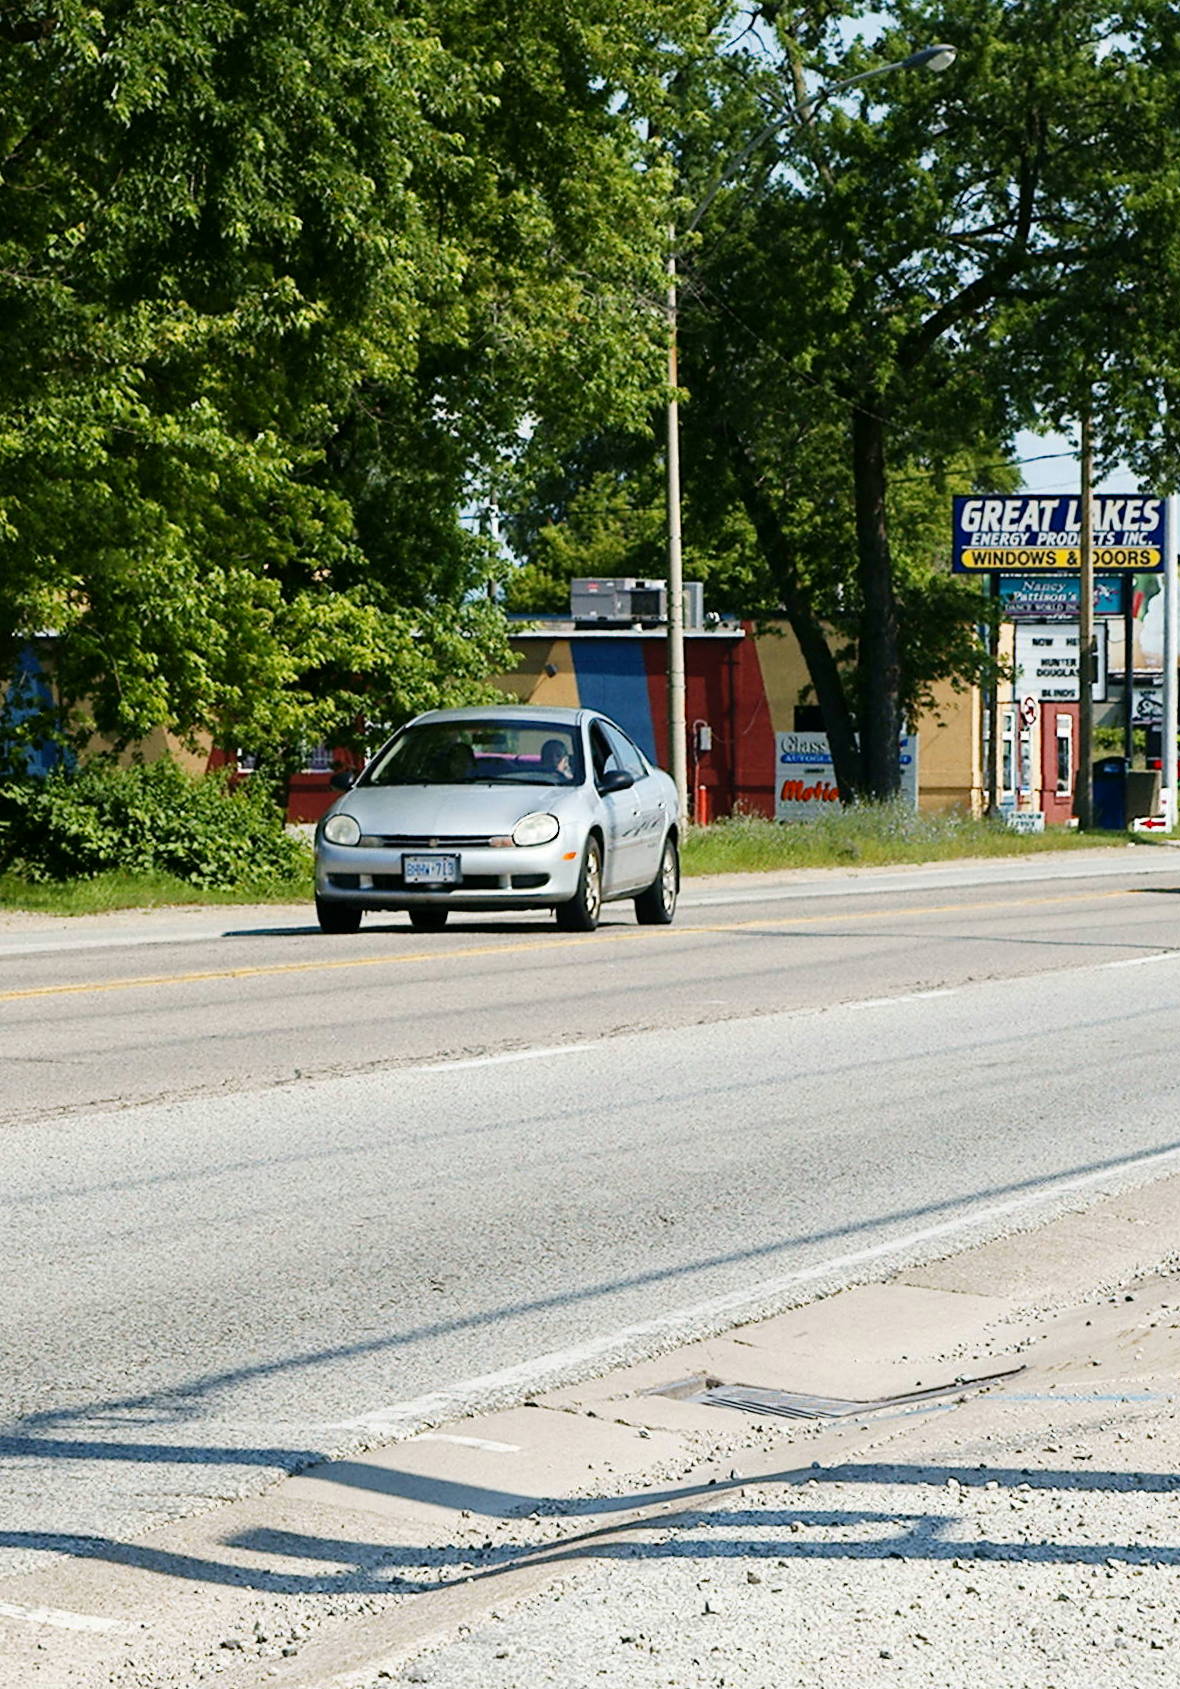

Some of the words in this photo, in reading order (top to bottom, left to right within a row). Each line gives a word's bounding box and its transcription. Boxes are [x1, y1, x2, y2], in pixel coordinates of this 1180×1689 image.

[961, 499, 1059, 532] GREAT
[971, 532, 1029, 546] ENERGY
[1037, 532, 1115, 546] PRODTS
[1122, 532, 1153, 546] INC.
[972, 551, 1056, 565] WINDOWS
[1067, 551, 1078, 565] &
[1022, 580, 1066, 592] Nancy
[1013, 591, 1077, 602] Pattison's
[1032, 638, 1053, 646] NOW
[1041, 658, 1077, 666] HUNTER
[1041, 689, 1076, 697] BLINDS
[781, 779, 840, 801] Motio
